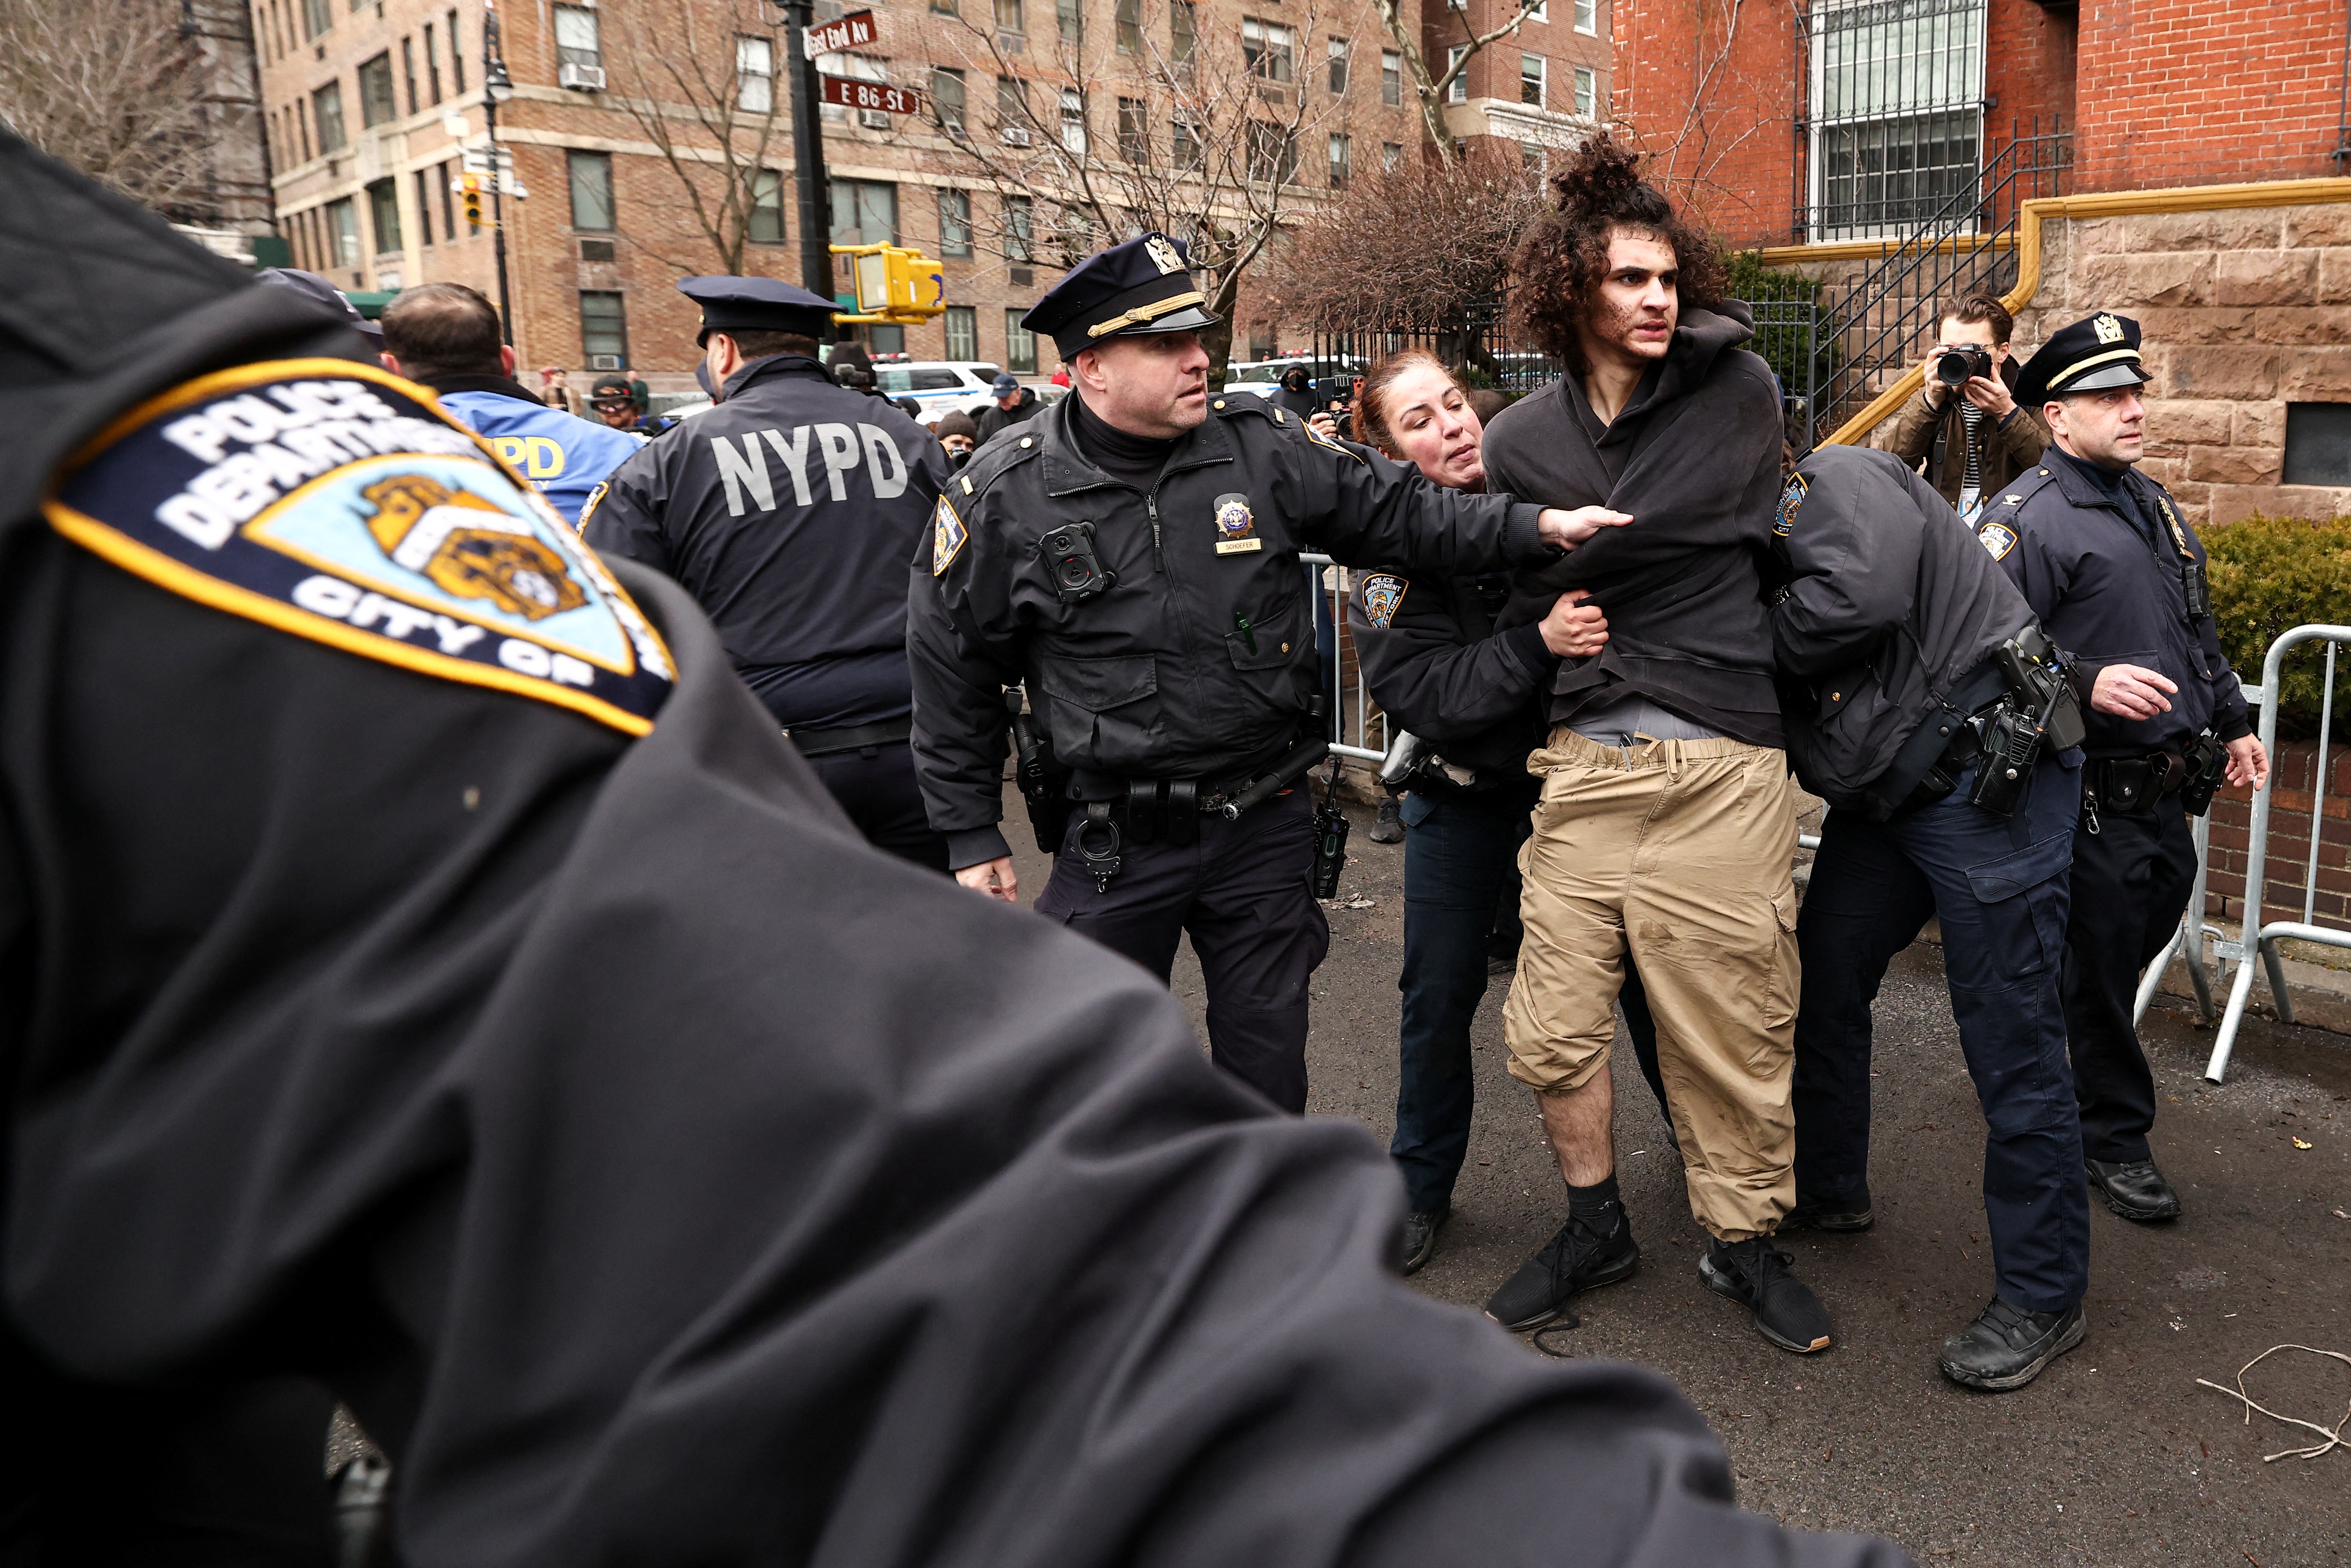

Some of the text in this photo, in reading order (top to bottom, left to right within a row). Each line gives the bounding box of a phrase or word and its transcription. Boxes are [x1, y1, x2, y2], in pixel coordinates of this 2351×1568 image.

[826, 22, 850, 50] End
[852, 20, 869, 44] Av
[841, 83, 905, 112] E 86 St
[161, 380, 398, 465] POLICE
[710, 422, 908, 517] NYPD
[943, 504, 958, 529] POLICE
[1226, 542, 1253, 550] SCHOEFER
[1365, 583, 1401, 596] DEPARTMENT
[1371, 577, 1395, 586] POLICE
[1387, 595, 1400, 613] YORK
[291, 574, 488, 655] CITY
[498, 638, 596, 686] OF
[2018, 728, 2036, 736] MOTOROL
